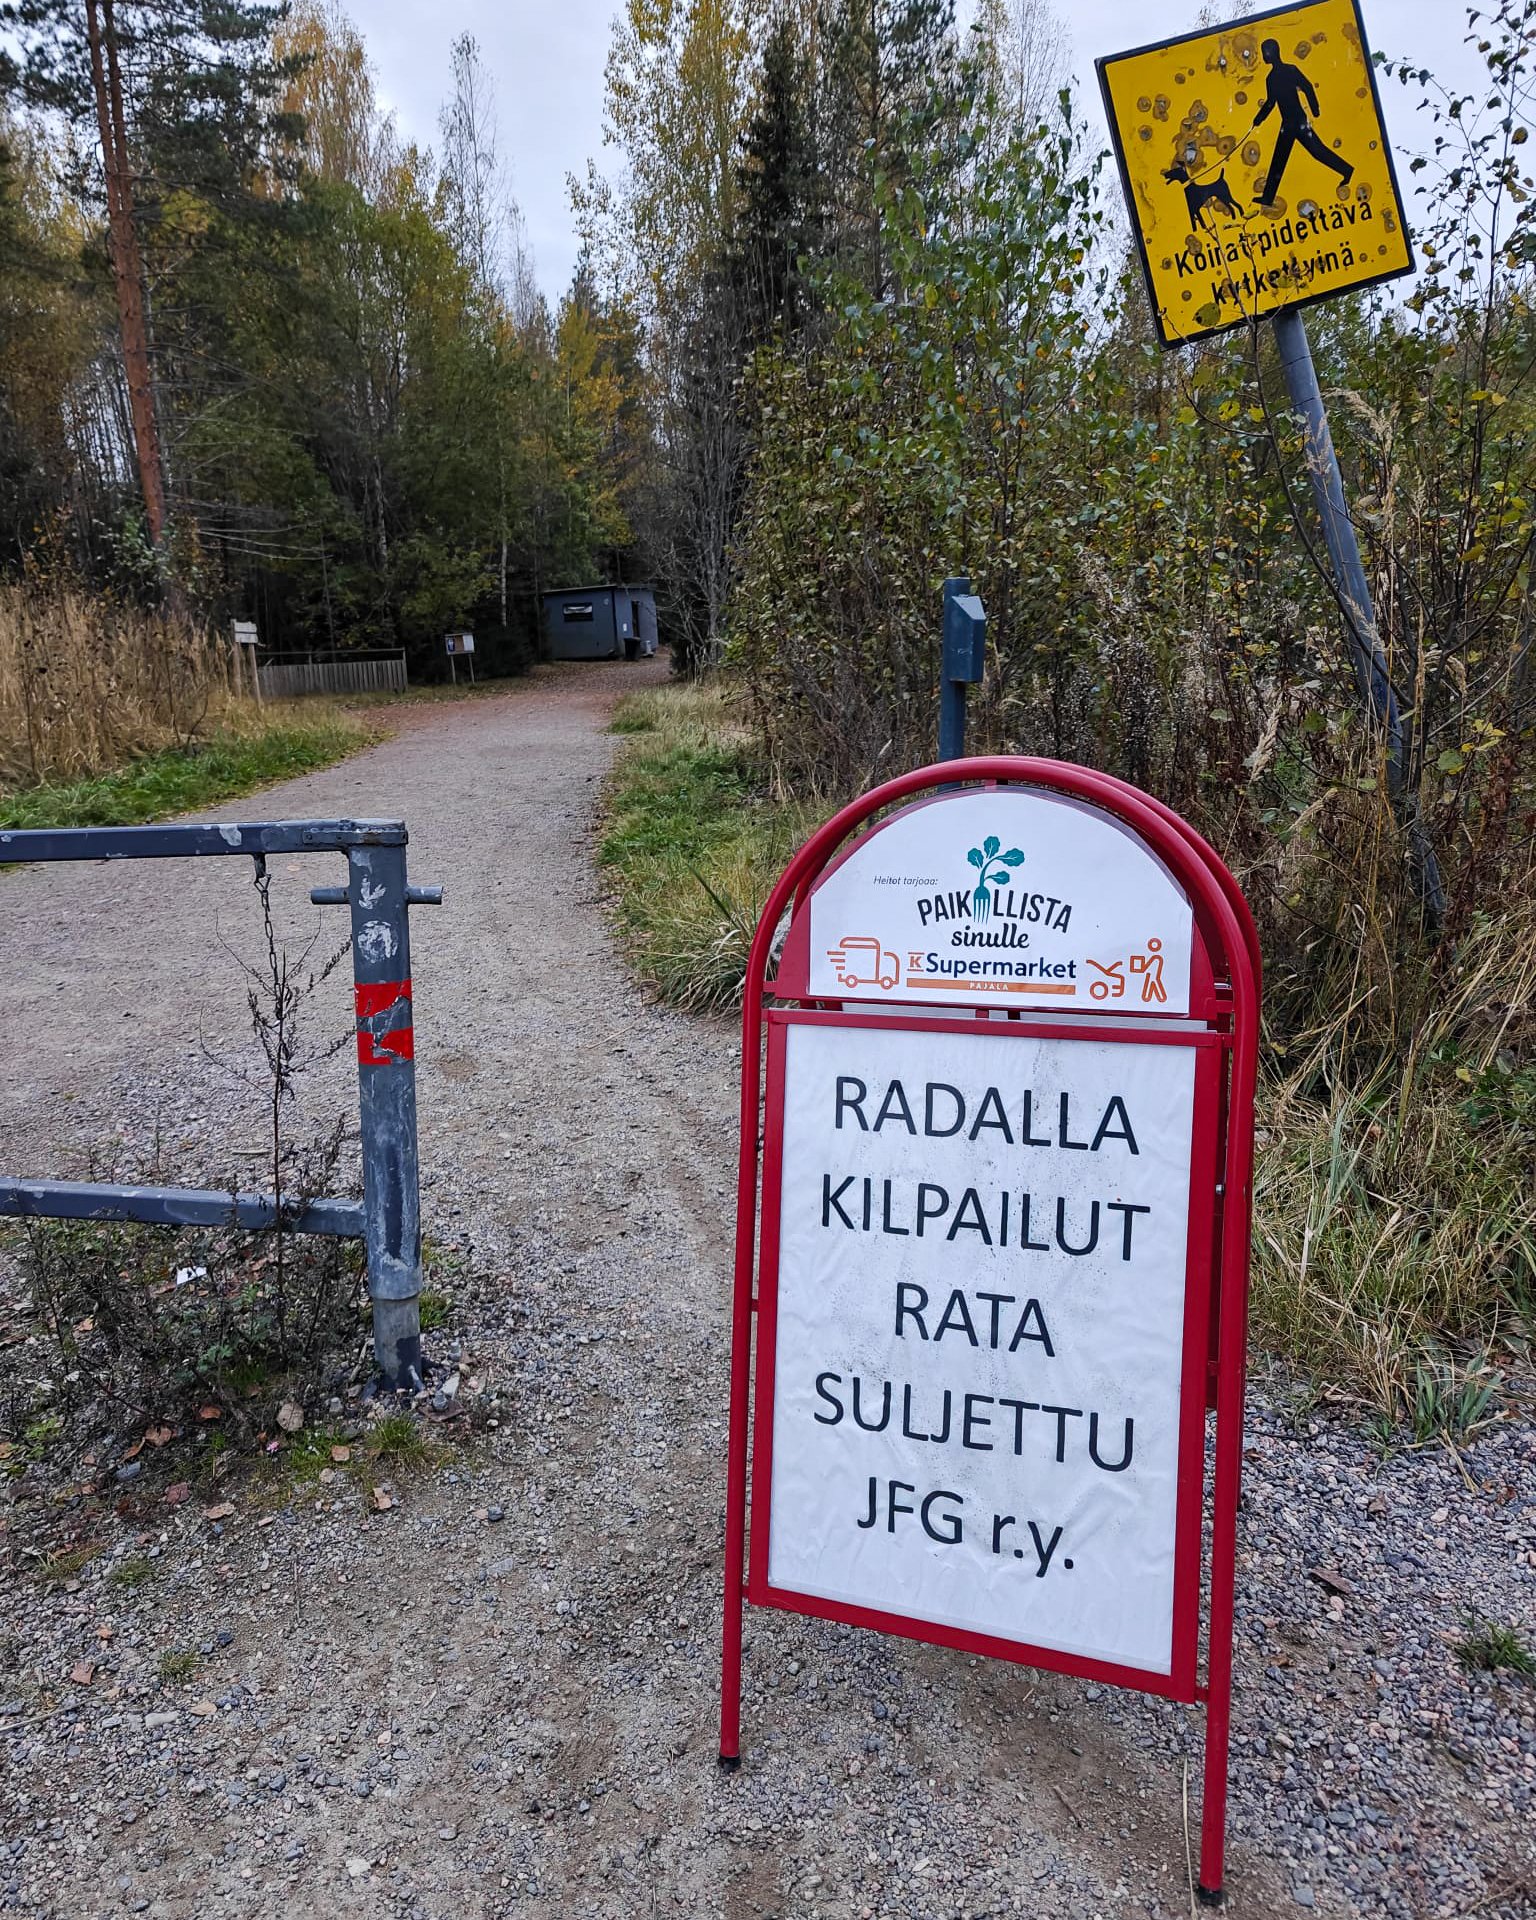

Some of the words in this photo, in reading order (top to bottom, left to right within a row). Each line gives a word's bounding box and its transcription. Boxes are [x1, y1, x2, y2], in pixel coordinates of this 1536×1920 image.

[1174, 232, 1252, 279] Koirat
[1258, 194, 1373, 258] pidettävä
[873, 875, 901, 885] Heitot
[916, 888, 1073, 934] PAIKLLISTA
[925, 952, 1077, 979] Supermarket
[950, 922, 1030, 949] sinulle
[969, 981, 1009, 992] PAJALA
[834, 1075, 1140, 1156] RADALLA
[821, 1173, 1151, 1262] KILPAILUT
[895, 1281, 1056, 1358] RATA
[813, 1371, 1135, 1473] SULJETTU
[856, 1476, 964, 1545] JFG
[992, 1513, 1075, 1578] r.y.
